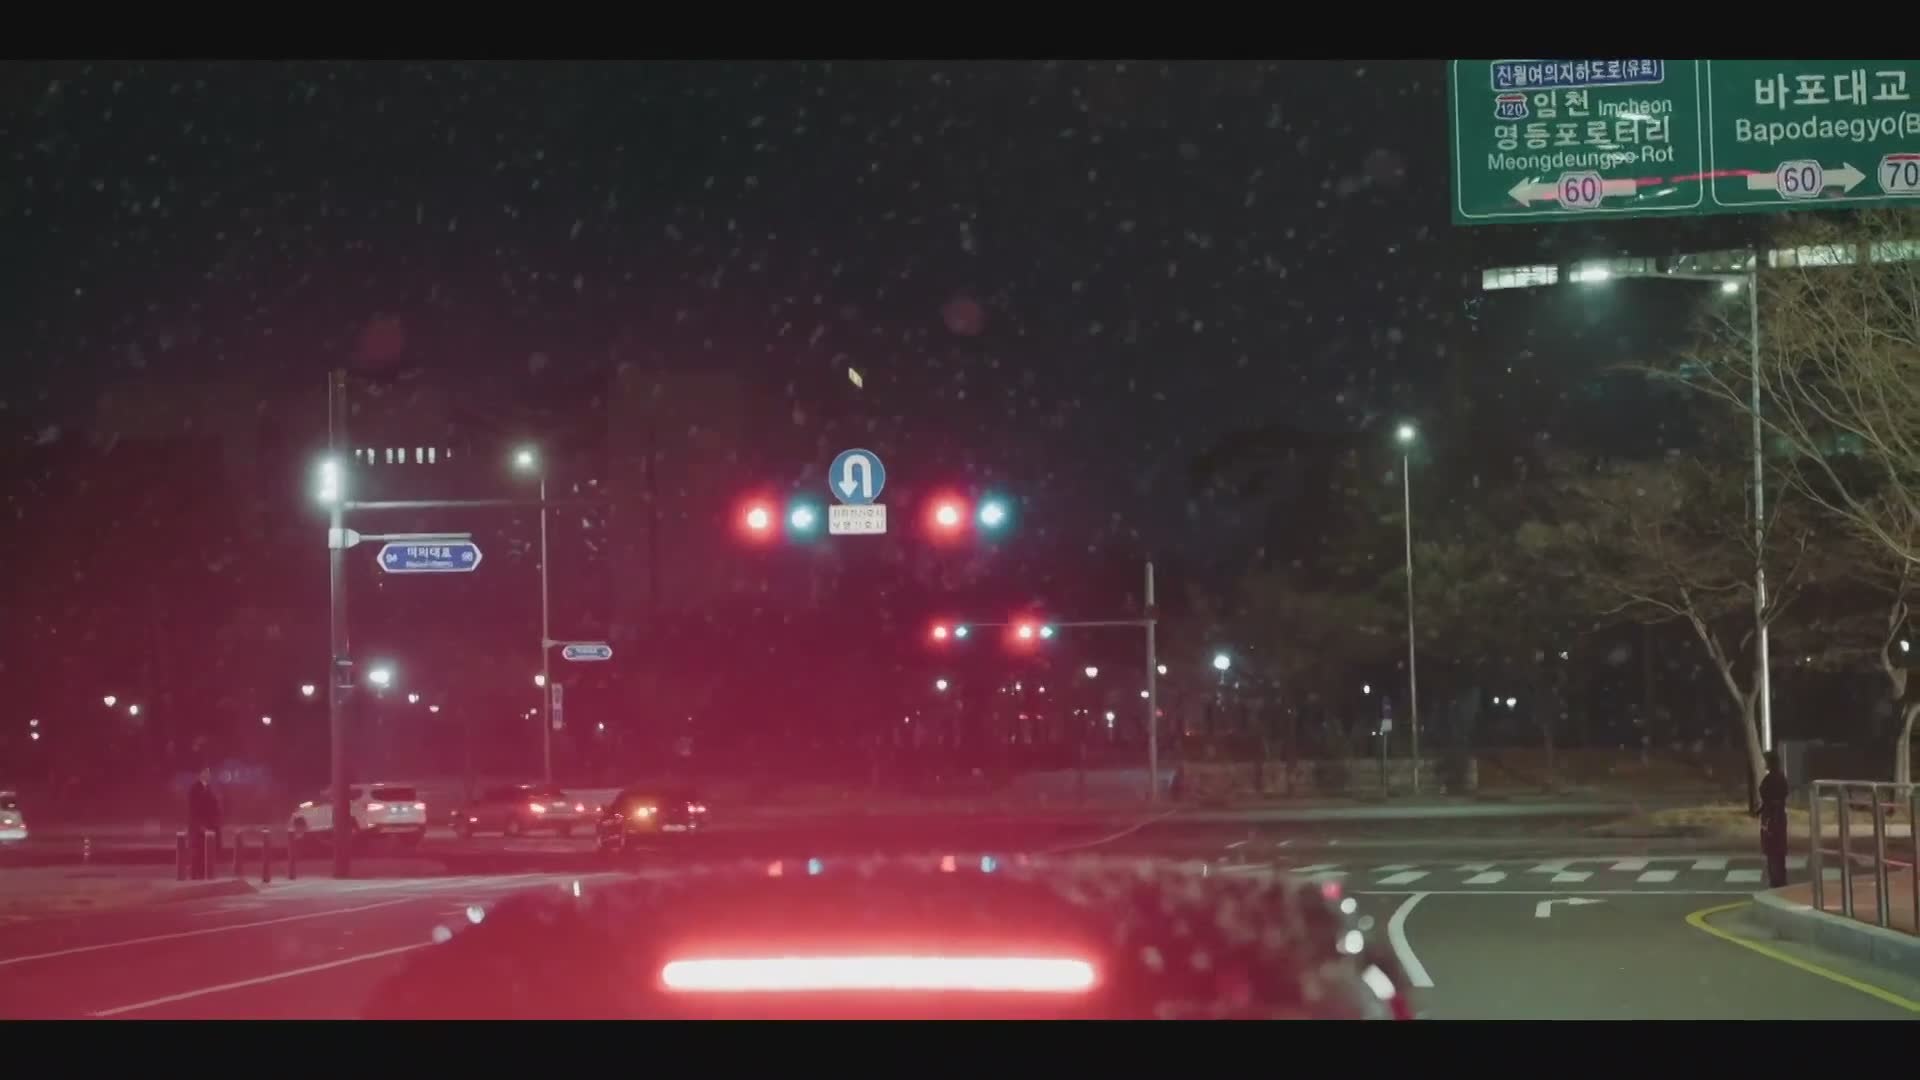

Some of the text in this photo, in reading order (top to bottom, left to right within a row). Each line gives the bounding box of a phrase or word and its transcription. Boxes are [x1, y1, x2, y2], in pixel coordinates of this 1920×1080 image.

[1754, 69, 1910, 110] 바포대교
[1501, 103, 1523, 116] 120
[1598, 98, 1672, 117] Imcheon
[1641, 145, 1674, 163] Rot
[1784, 167, 1816, 193] 60
[1886, 161, 1919, 188] 70
[1565, 178, 1596, 202] 60
